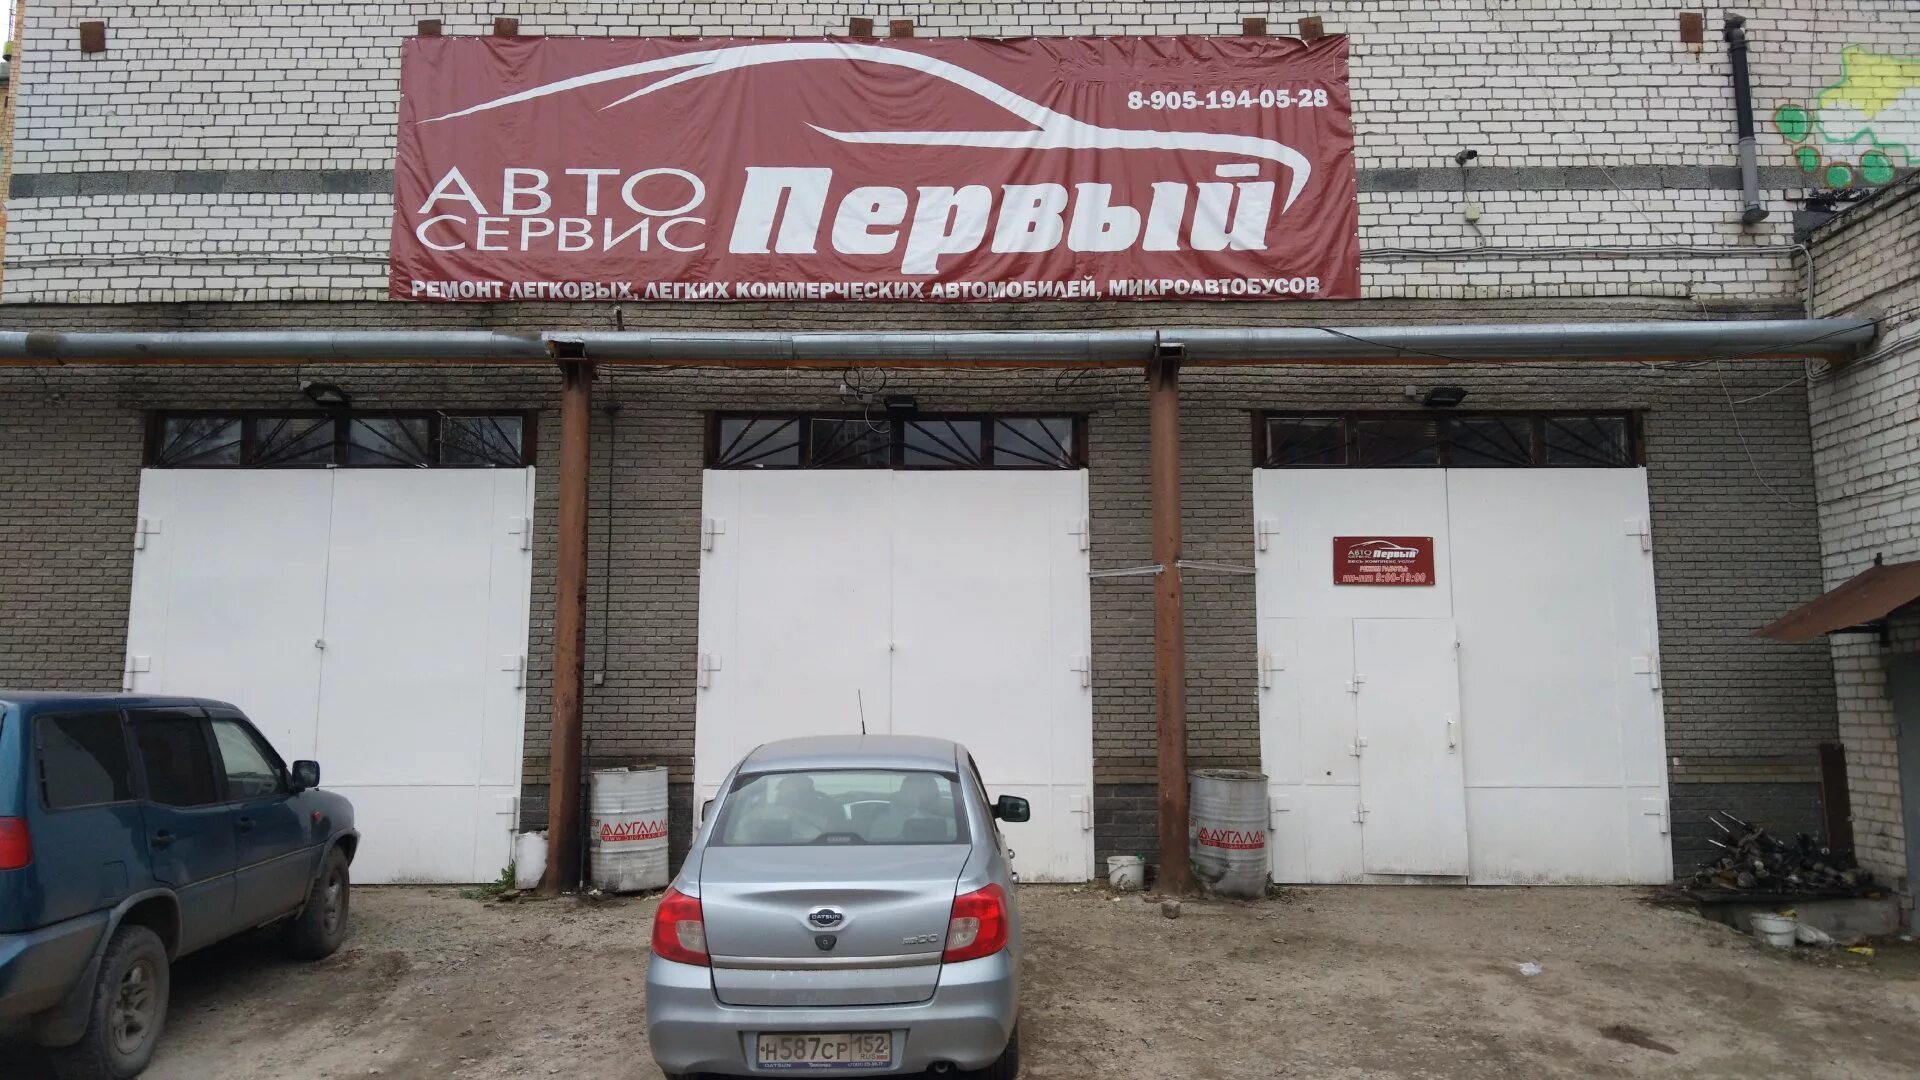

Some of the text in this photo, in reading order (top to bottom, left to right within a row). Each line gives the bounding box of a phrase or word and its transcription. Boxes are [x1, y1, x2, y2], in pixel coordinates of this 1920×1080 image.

[1127, 88, 1329, 110] 8-905-194-05-28
[417, 165, 706, 217] АВТО
[415, 215, 707, 252] СЕРВИС
[728, 163, 1276, 275] Первый
[411, 275, 1320, 300] РЕМОНТ ЛЕГКОВЫХ, ЛЕГКИХ КОММЕРЧЕСКИХ АВТОМОБИЛЕЙ, МИКРОАВТОБУСОВ
[1373, 550, 1416, 559] Первый
